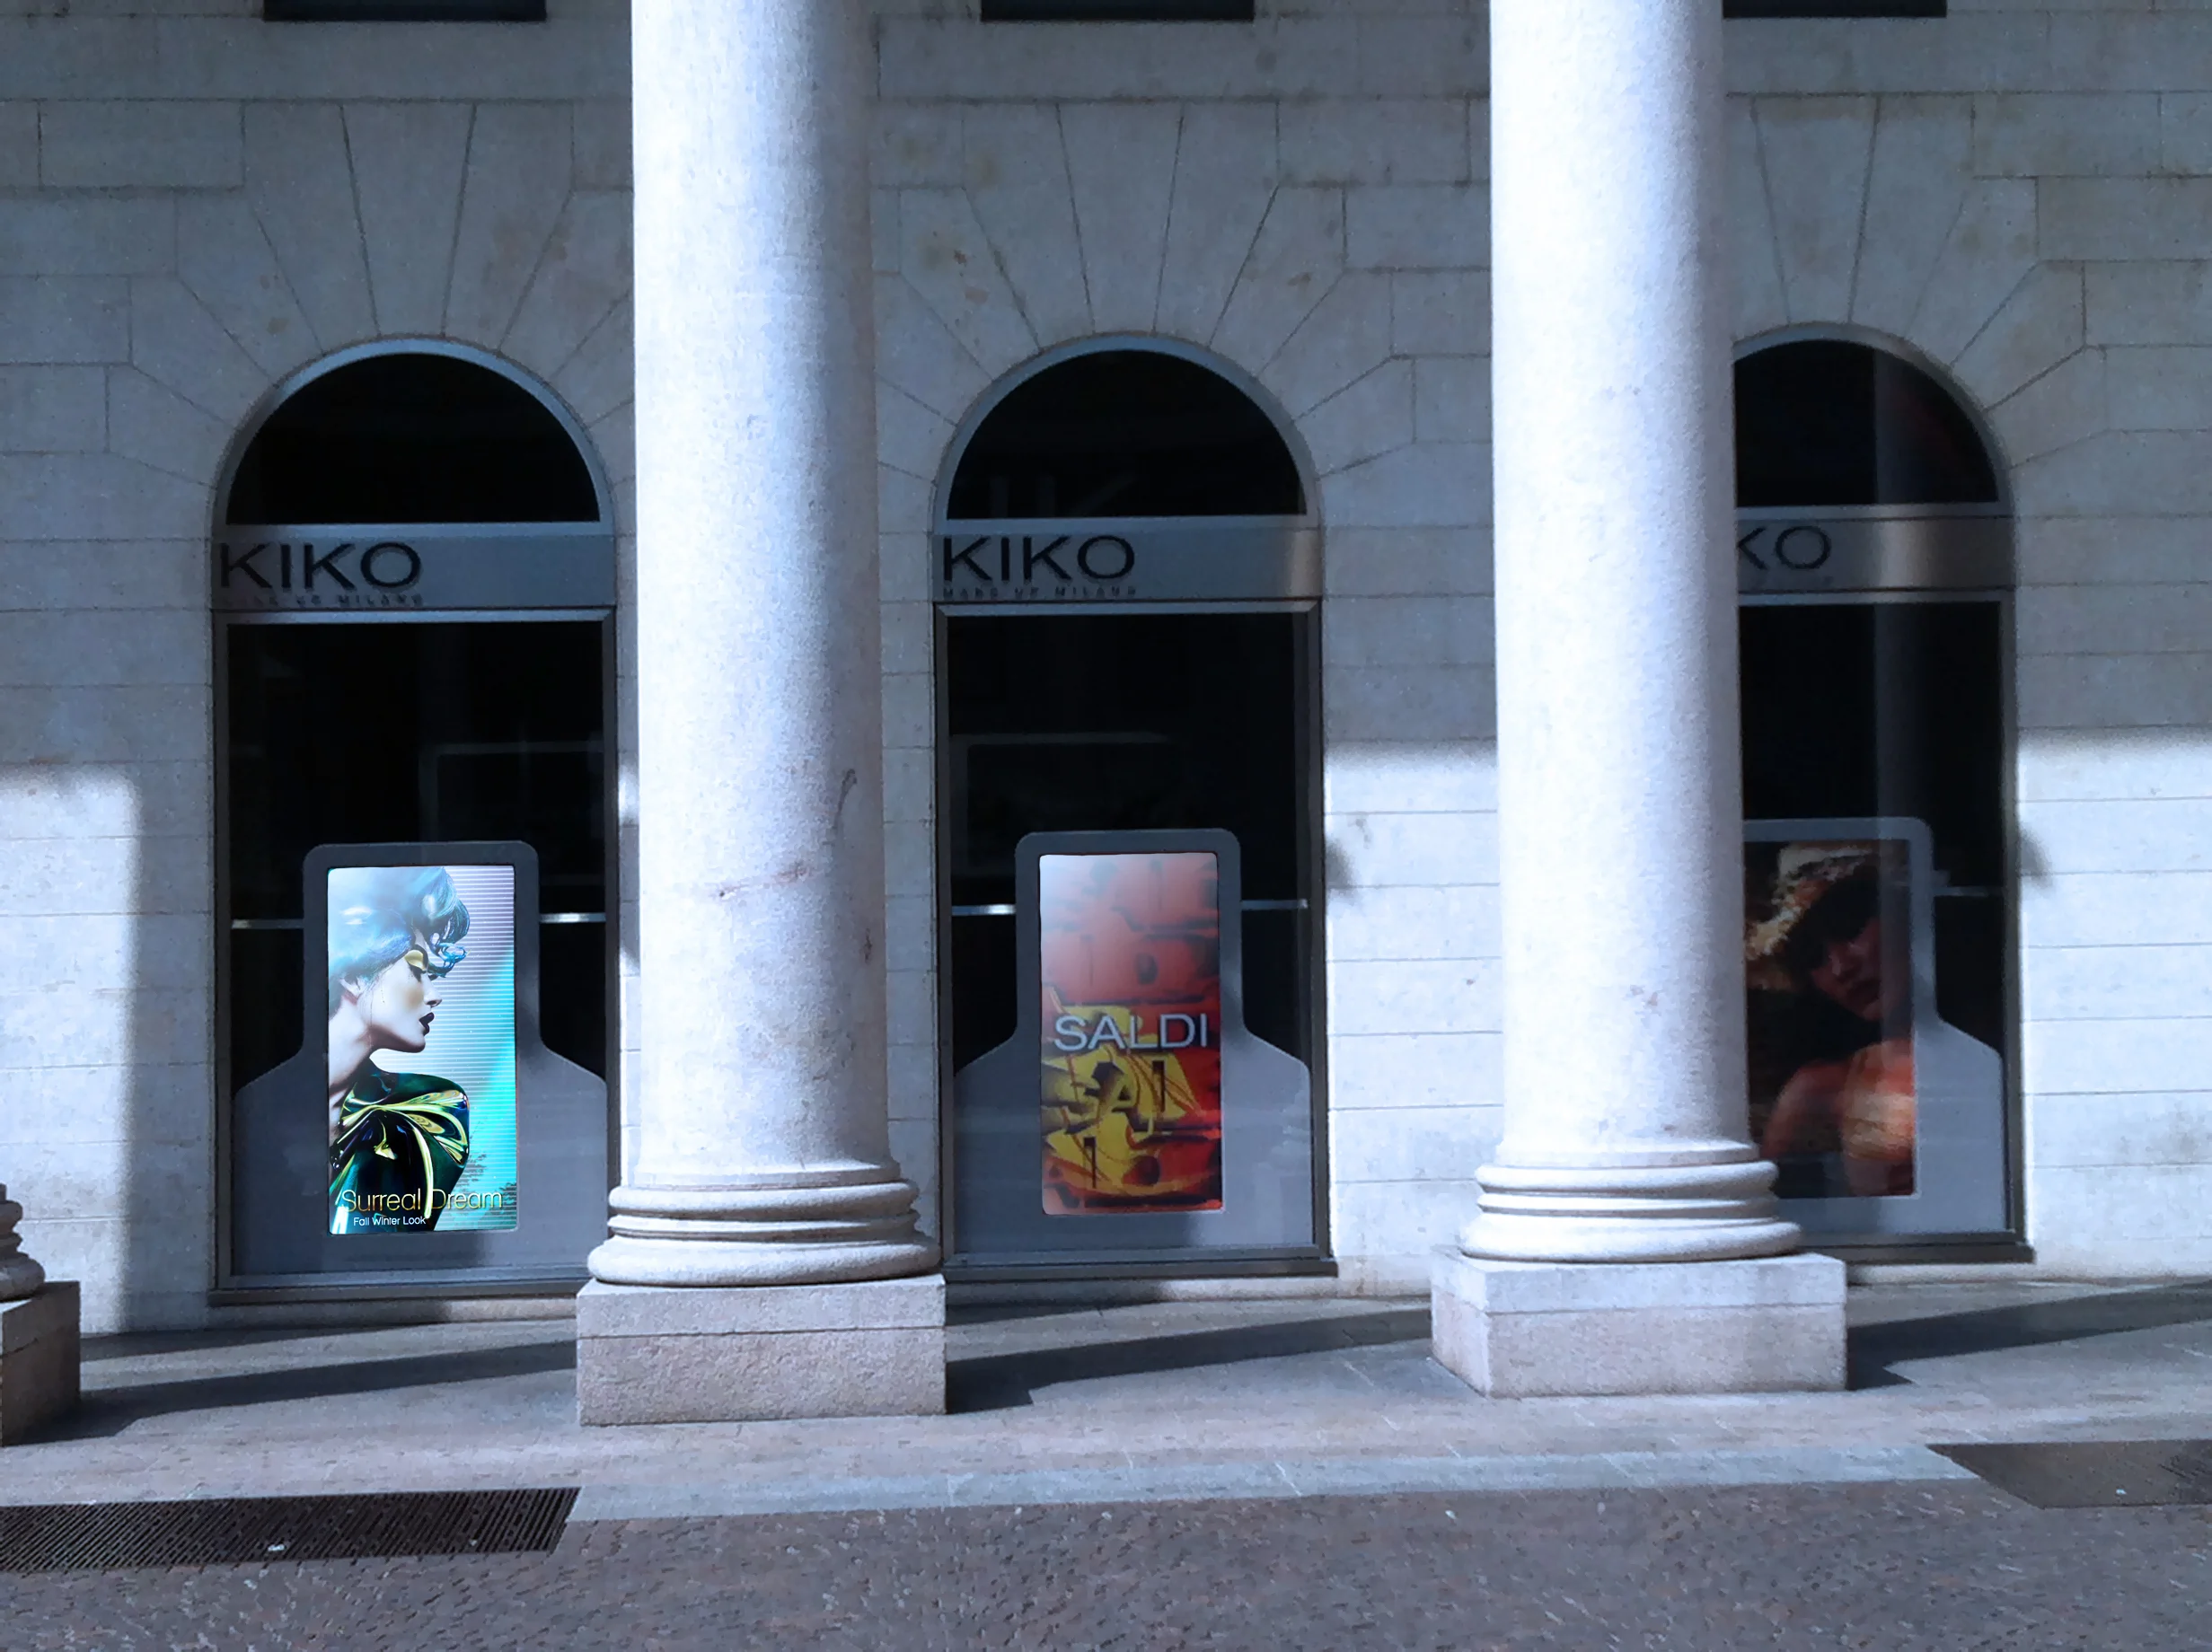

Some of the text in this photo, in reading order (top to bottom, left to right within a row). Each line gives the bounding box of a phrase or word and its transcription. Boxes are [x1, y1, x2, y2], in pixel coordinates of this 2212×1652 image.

[219, 541, 422, 590] KIKO
[943, 535, 1135, 583] KIKO
[1738, 525, 1831, 571] KO
[1053, 1013, 1209, 1051] SALDI
[341, 1188, 503, 1212] Surreal Dream
[353, 1215, 427, 1226] Fall Winter Look
